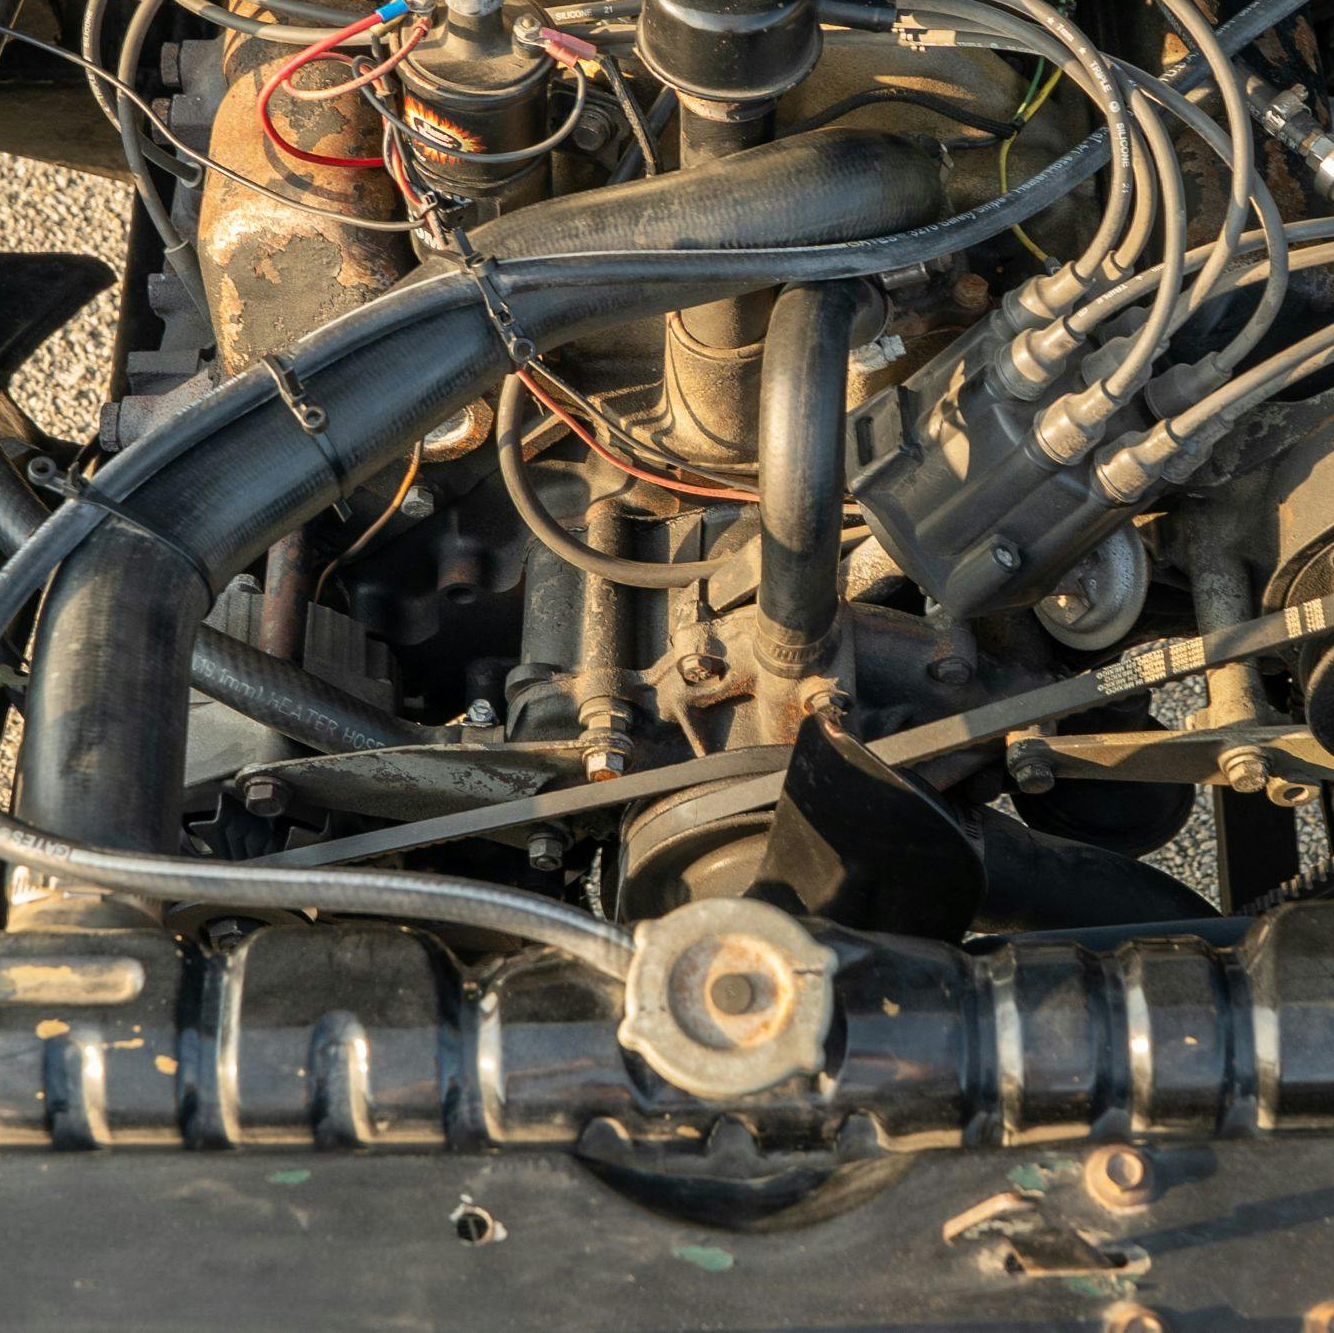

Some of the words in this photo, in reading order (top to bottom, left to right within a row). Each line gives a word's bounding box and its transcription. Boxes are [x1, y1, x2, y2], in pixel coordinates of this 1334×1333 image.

[554, 8, 593, 21] SILICONE
[1116, 122, 1131, 169] SILICONE
[267, 691, 339, 736] HEATER
